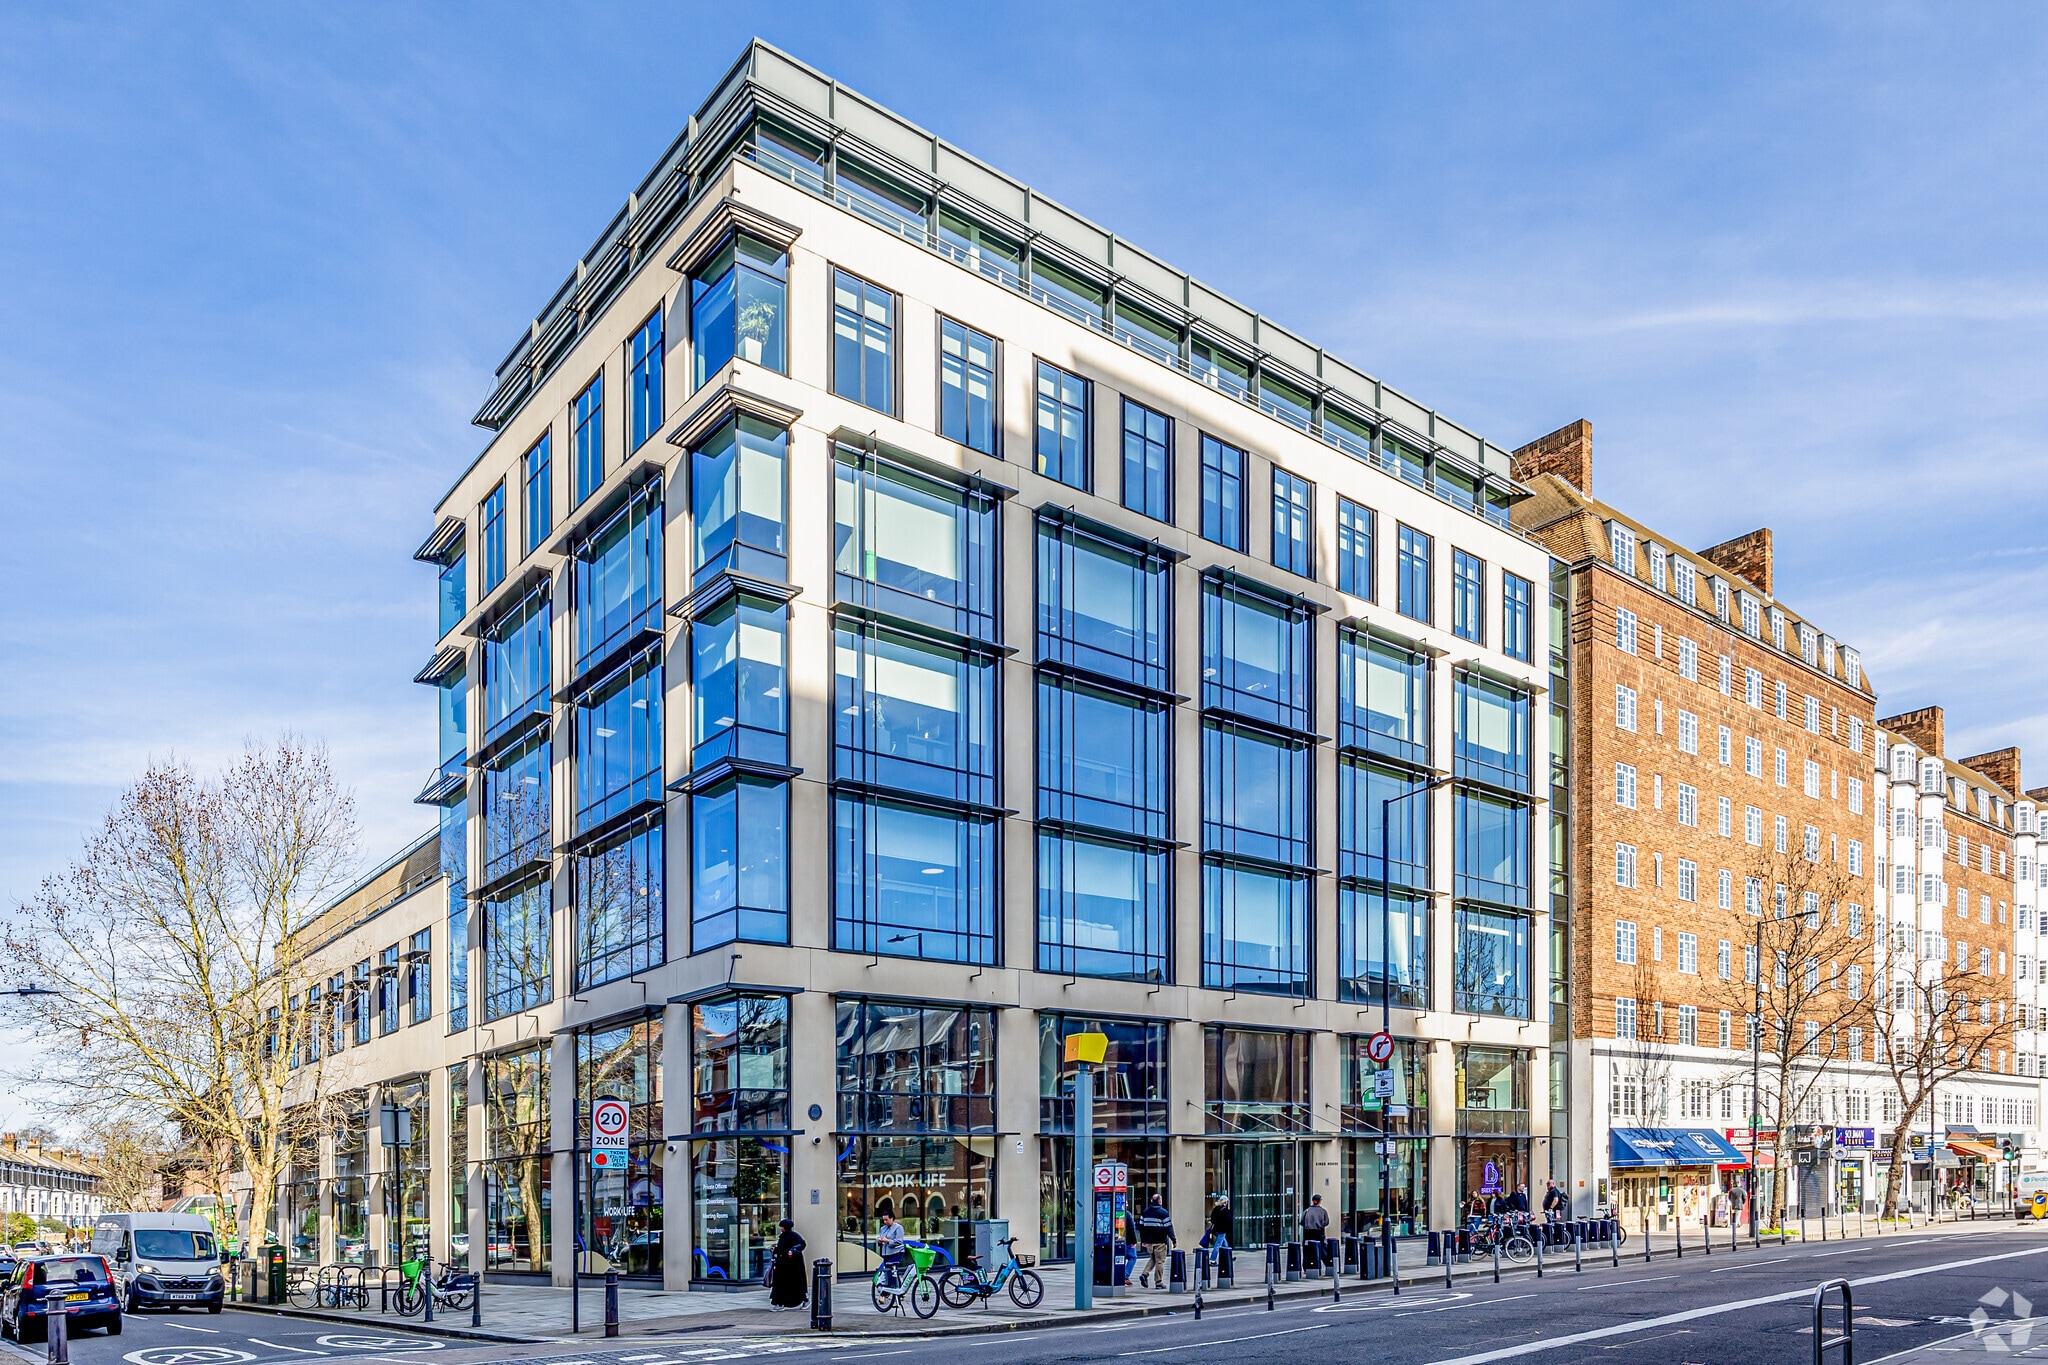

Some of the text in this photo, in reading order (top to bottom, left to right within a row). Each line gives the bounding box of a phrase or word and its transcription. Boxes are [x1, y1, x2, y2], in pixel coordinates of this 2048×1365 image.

[600, 1112, 622, 1125] 20
[596, 1136, 625, 1146] ZONE
[715, 1182, 728, 1190] Offices
